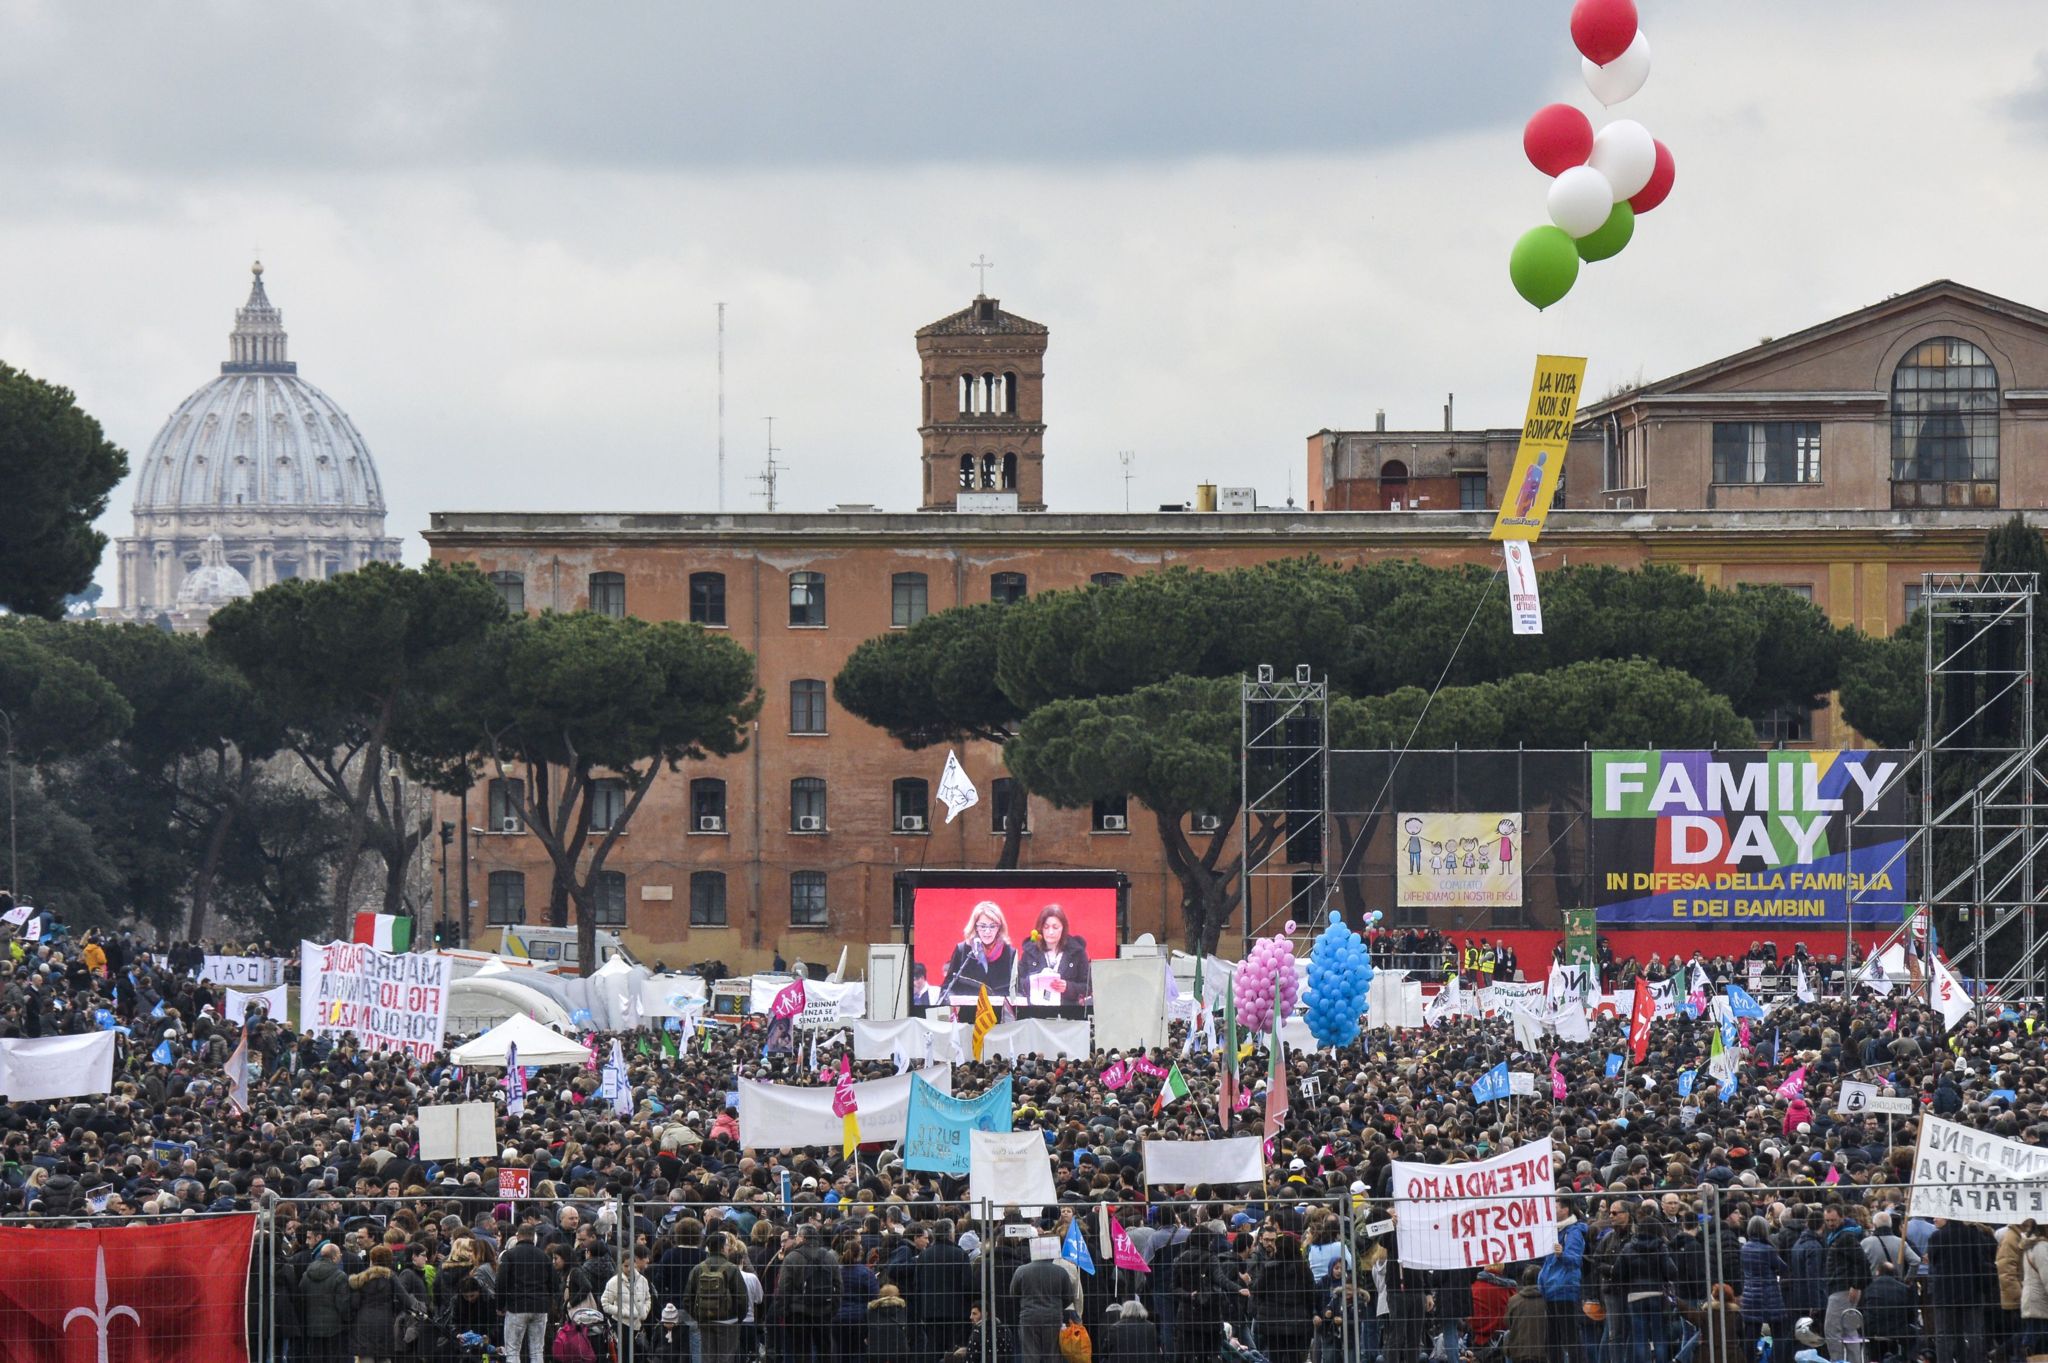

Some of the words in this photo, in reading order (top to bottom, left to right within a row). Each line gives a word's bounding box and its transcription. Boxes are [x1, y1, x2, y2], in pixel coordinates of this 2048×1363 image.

[1538, 372, 1551, 393] LA
[1554, 373, 1577, 394] VITA
[1536, 396, 1557, 417] NON
[1559, 397, 1571, 417] SI
[1525, 419, 1571, 441] COMPRA
[1605, 762, 1898, 811] FAMILY
[1670, 815, 1832, 865] DAY
[1440, 880, 1483, 890] COMITATO
[1606, 872, 1628, 890] IN
[1633, 872, 1714, 891] DIFESA
[1715, 872, 1785, 890] DELLA
[1790, 872, 1893, 890] FAMIGLIA
[1403, 891, 1456, 901] DIFENDIAMO
[1463, 891, 1494, 901] NOSTRI
[1496, 891, 1519, 901] FIGLI
[1673, 899, 1688, 917] E
[1692, 899, 1729, 917] DEI
[1734, 899, 1825, 917] BAMBINI
[1304, 1084, 1311, 1096] 4
[518, 1176, 528, 1199] 3
